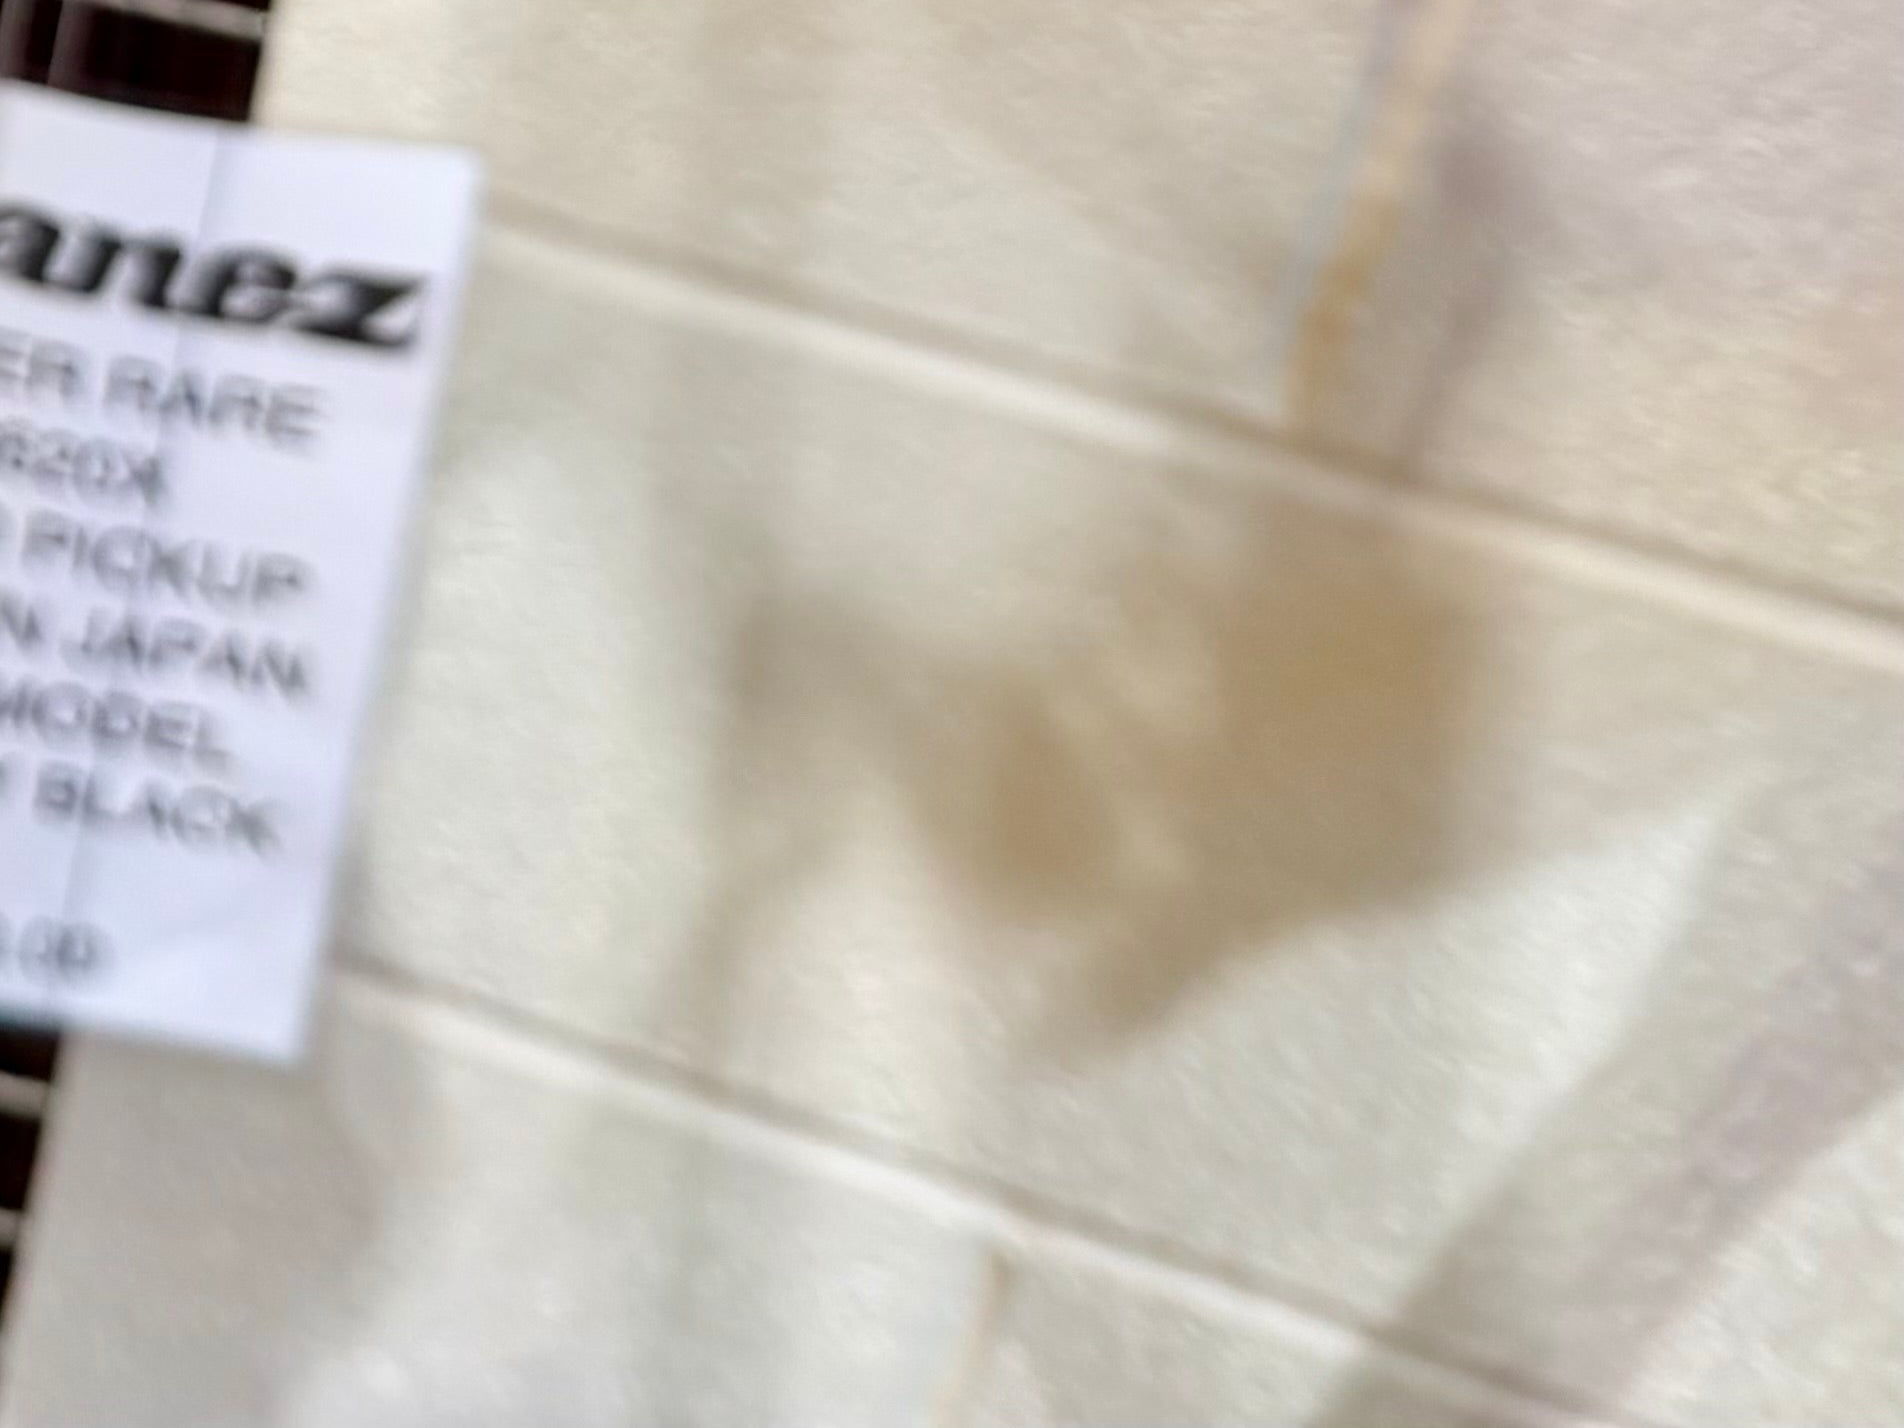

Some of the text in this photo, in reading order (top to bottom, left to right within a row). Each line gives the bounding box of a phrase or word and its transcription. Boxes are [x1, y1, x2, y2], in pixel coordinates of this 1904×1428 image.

[106, 356, 324, 444] RARE
[24, 510, 312, 616] PICKUP
[62, 606, 312, 700] JAPAN
[34, 760, 284, 856] BLACK
